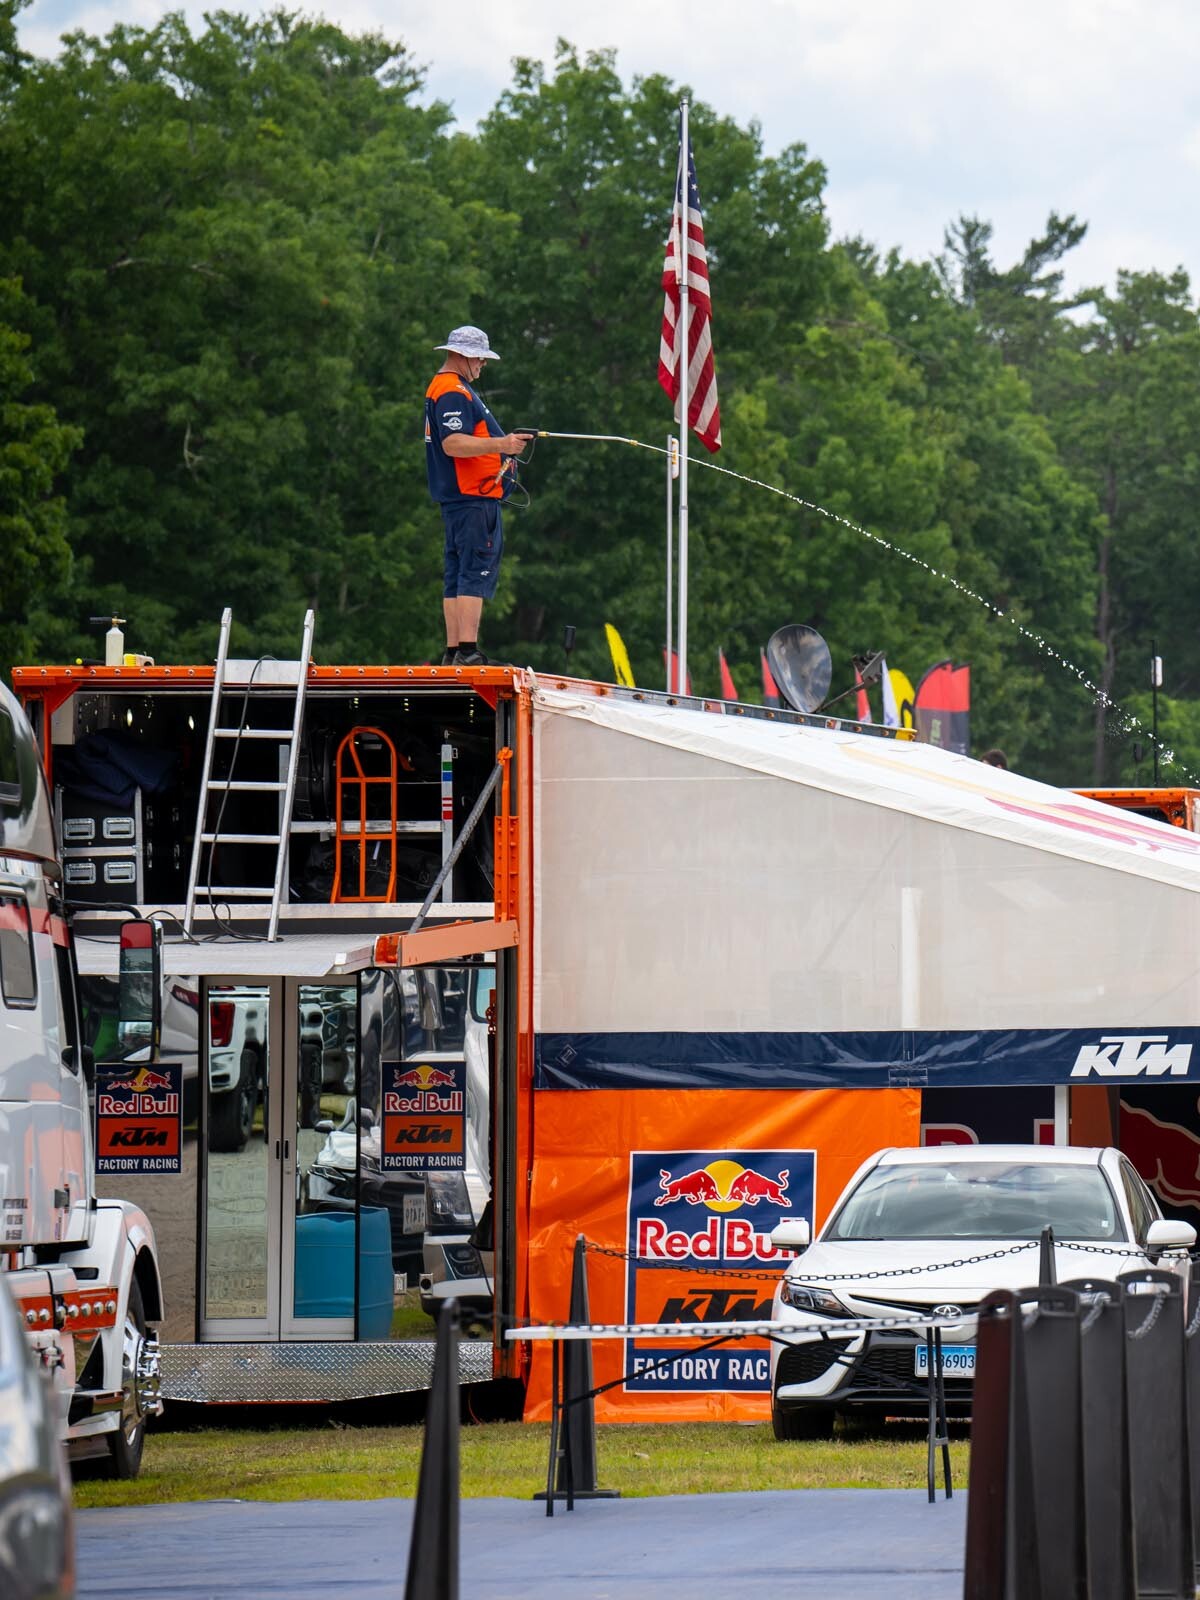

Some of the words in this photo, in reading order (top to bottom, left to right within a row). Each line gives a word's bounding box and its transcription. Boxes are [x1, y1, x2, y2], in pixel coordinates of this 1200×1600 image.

[1070, 1035, 1193, 1077] KTM
[99, 1093, 139, 1115] Red
[140, 1093, 179, 1115] Bull
[384, 1091, 424, 1112] Red
[425, 1091, 463, 1112] Bull
[108, 1127, 169, 1147] KTM
[395, 1124, 453, 1144] KTM
[98, 1158, 140, 1170] FACTORY
[143, 1158, 179, 1169] RACING
[384, 1156, 425, 1167] FACTORY
[428, 1155, 463, 1167] RACING
[637, 1216, 721, 1260] Red
[633, 1358, 721, 1381] FACTORY
[728, 1358, 772, 1381] RAC
